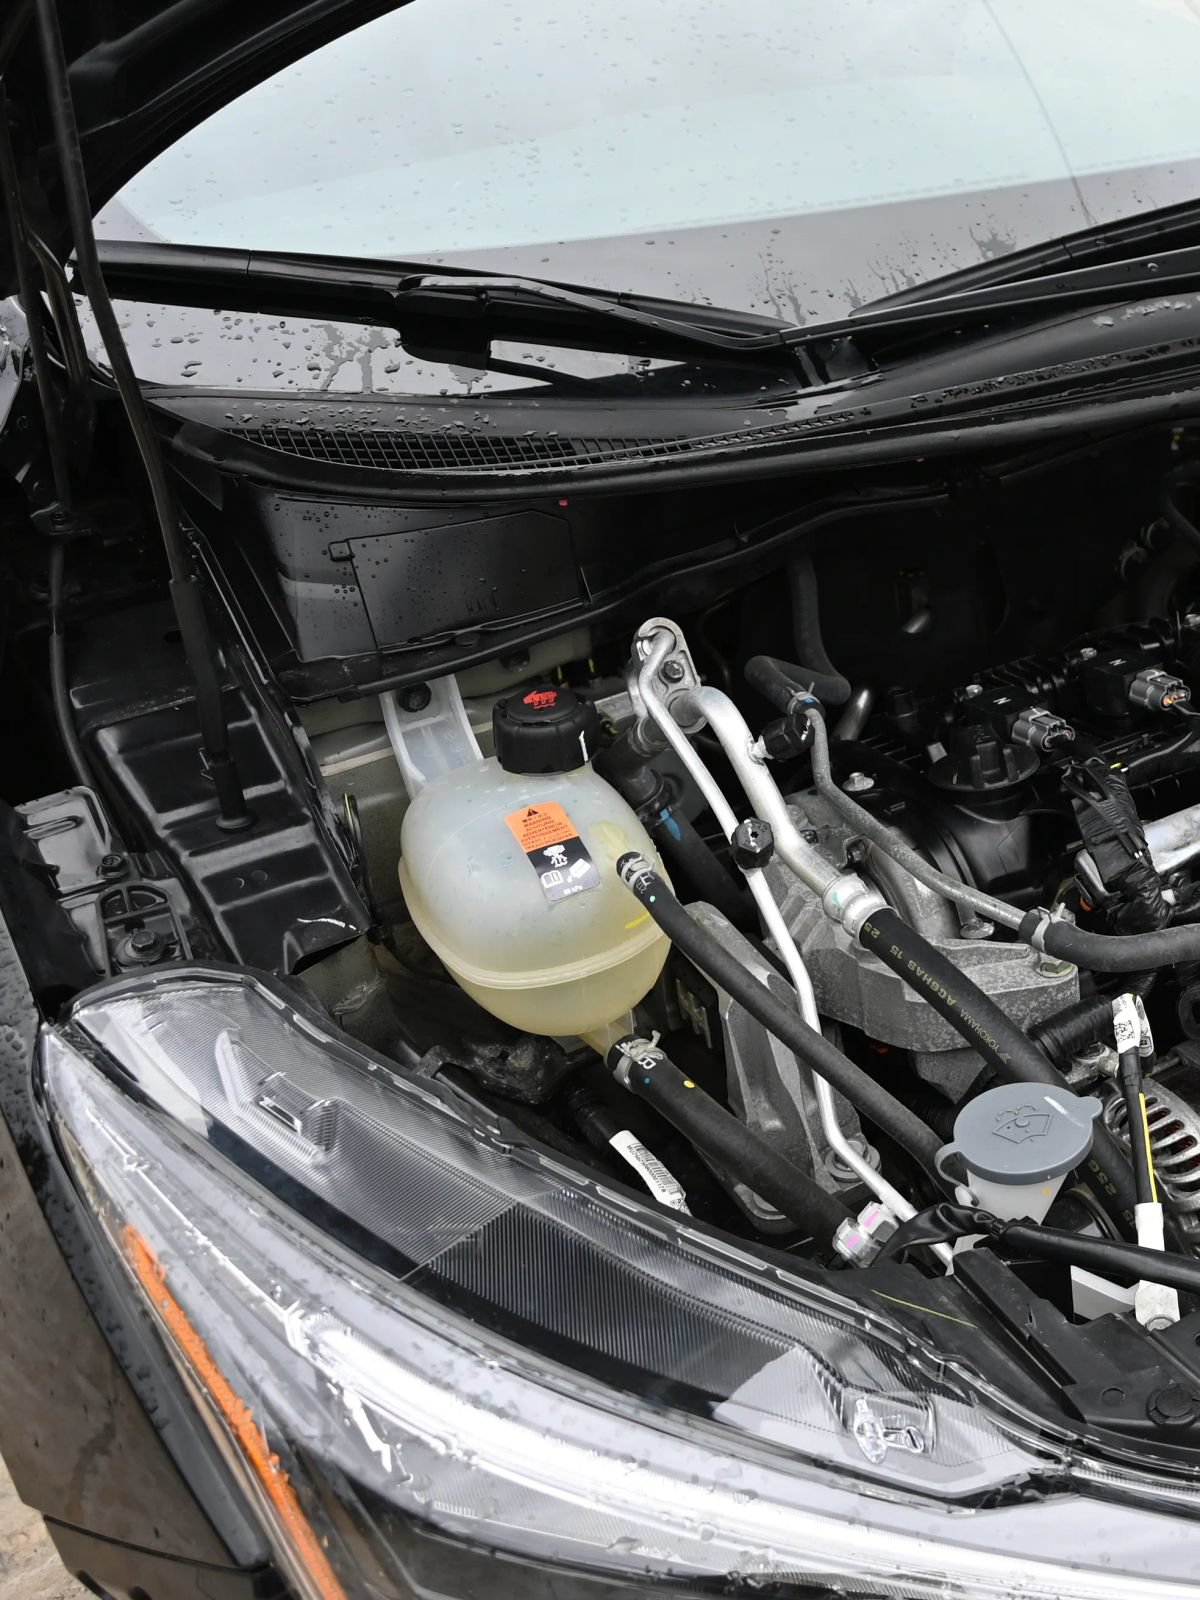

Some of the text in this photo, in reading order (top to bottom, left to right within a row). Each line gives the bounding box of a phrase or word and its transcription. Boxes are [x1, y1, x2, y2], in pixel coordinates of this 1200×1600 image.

[863, 921, 881, 939] 25
[890, 944, 904, 959] 15
[960, 1008, 1000, 1053] YOKOHAMA
